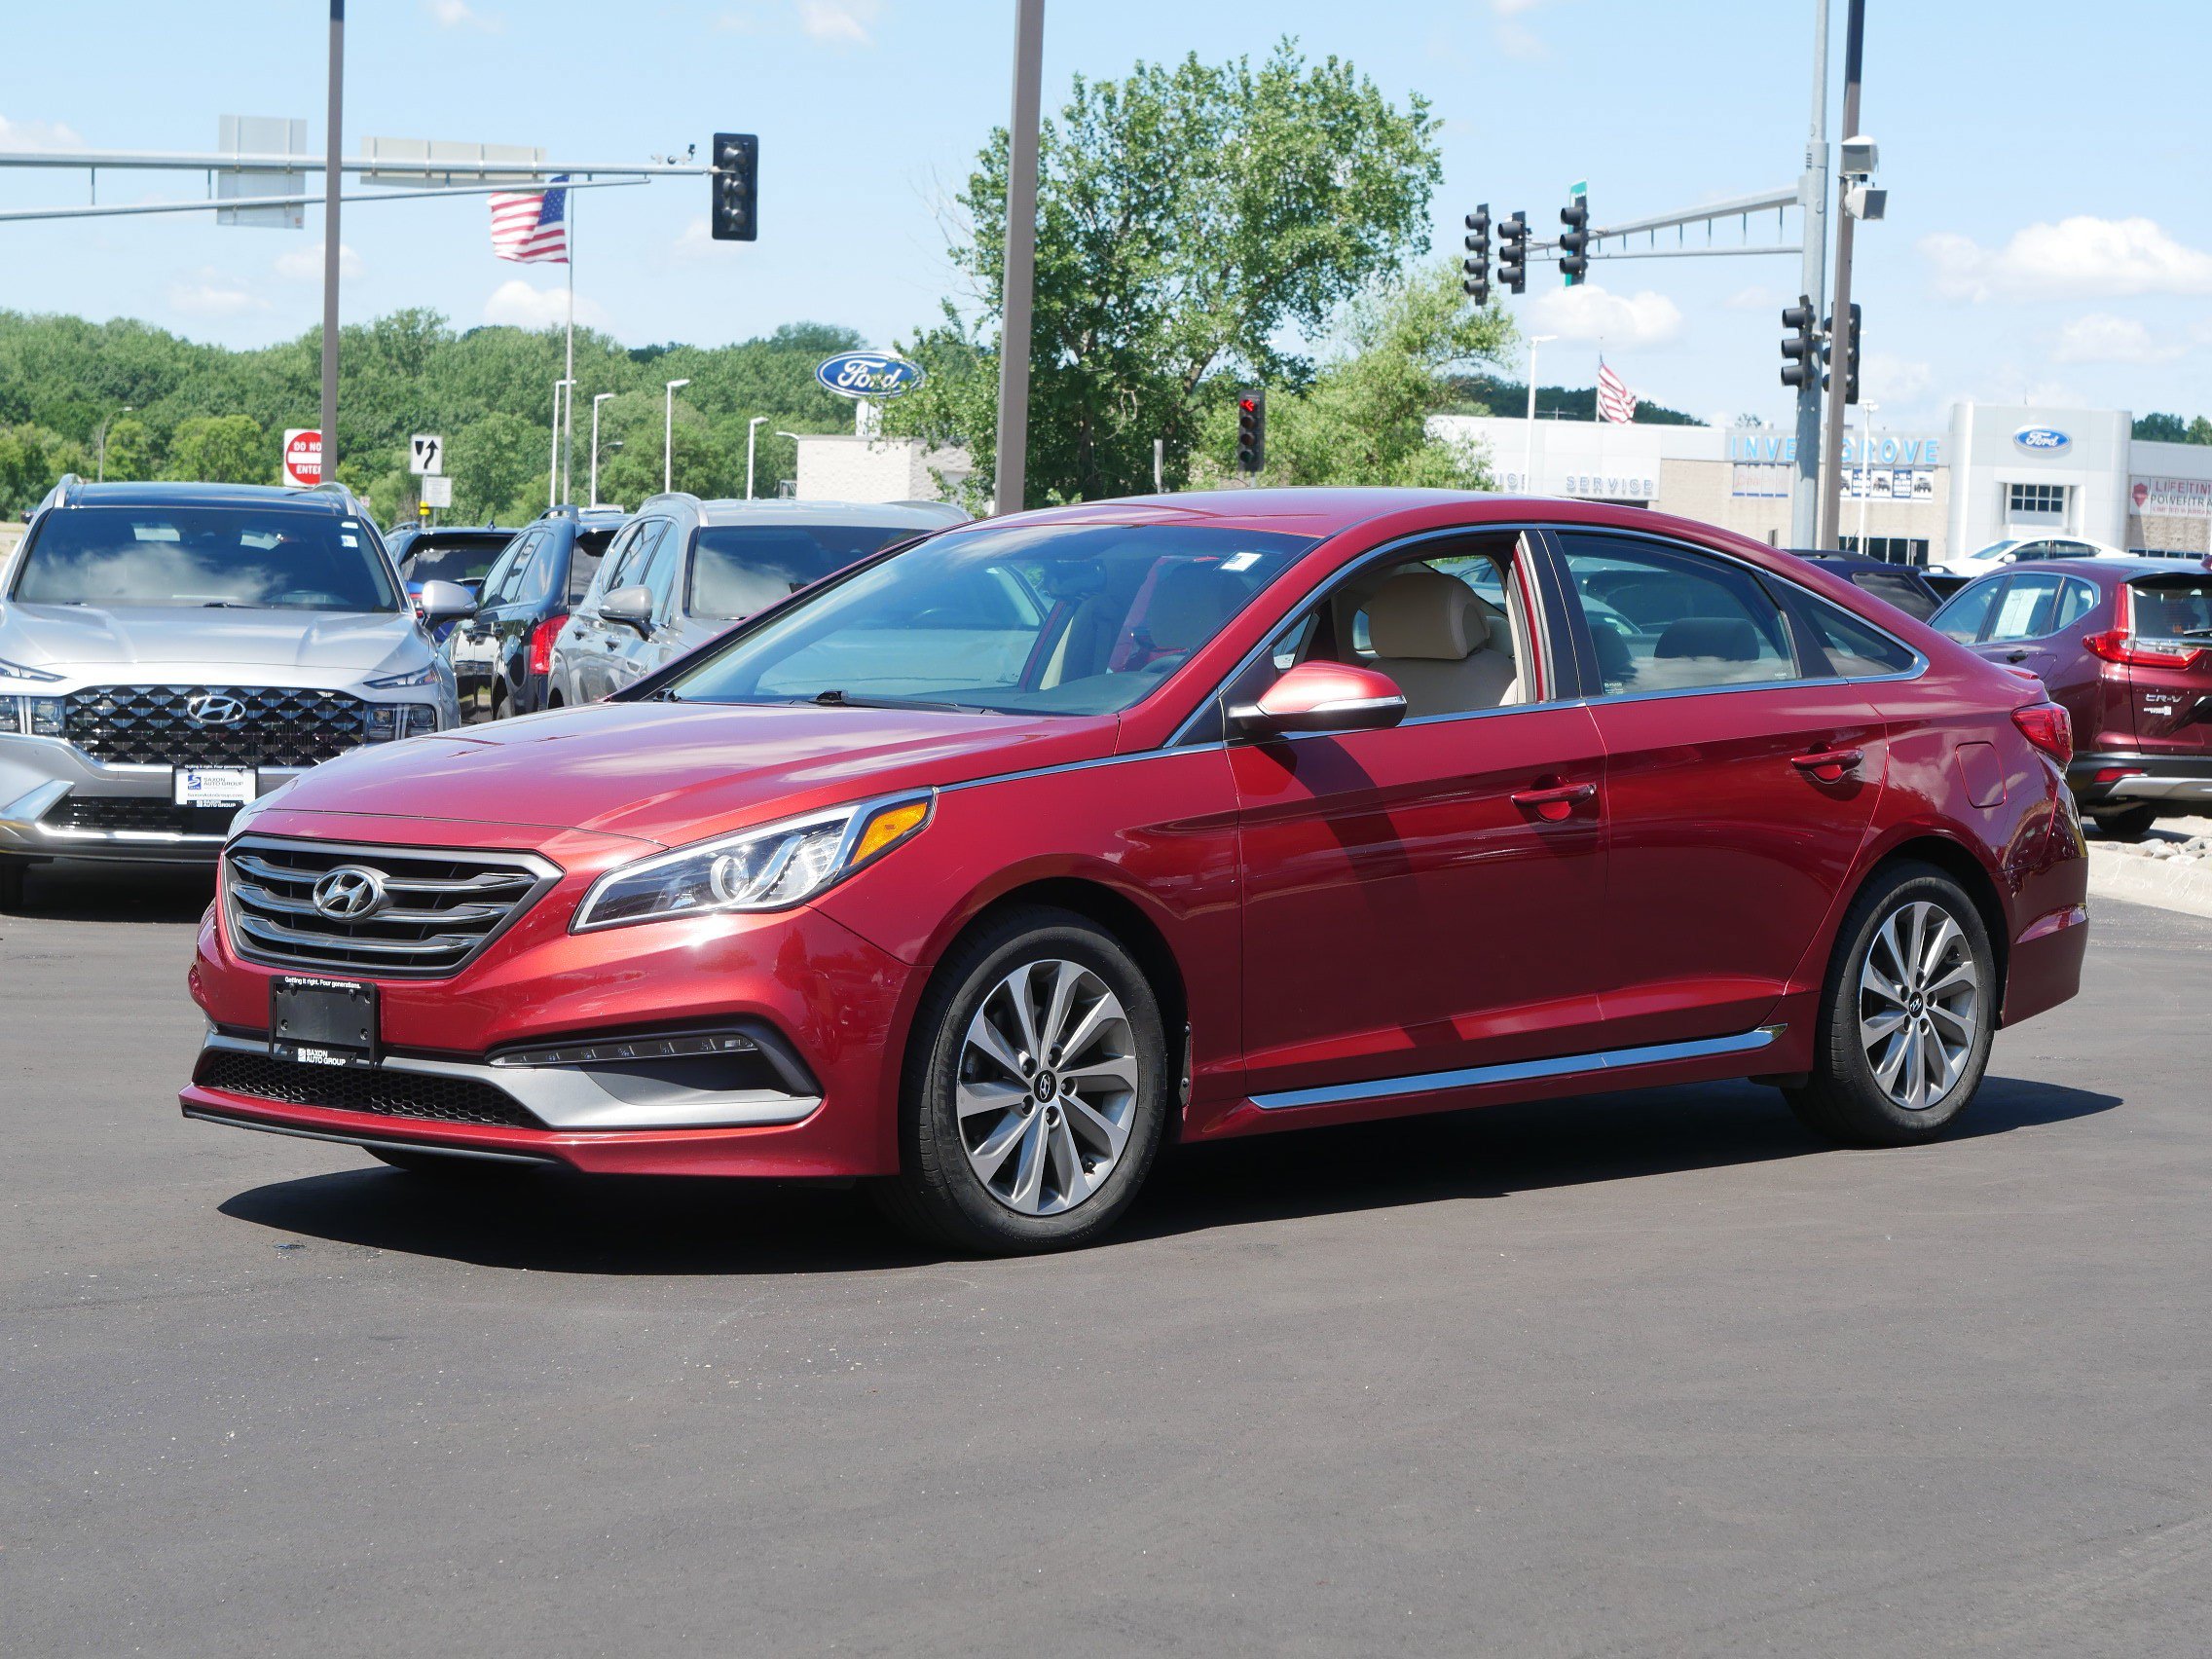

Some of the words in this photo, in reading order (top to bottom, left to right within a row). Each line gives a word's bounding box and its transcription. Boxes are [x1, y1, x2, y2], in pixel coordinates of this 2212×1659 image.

[837, 360, 903, 388] Ford
[2025, 430, 2059, 446] Ford
[293, 441, 307, 452] DO
[309, 441, 321, 452] NO
[1731, 435, 1797, 461] INVE
[1841, 437, 1939, 463] GROVE
[1566, 475, 1653, 493] SERVICE
[2145, 693, 2182, 703] CR-V
[306, 1049, 328, 1058] SAXON
[323, 1057, 347, 1066] GROUP
